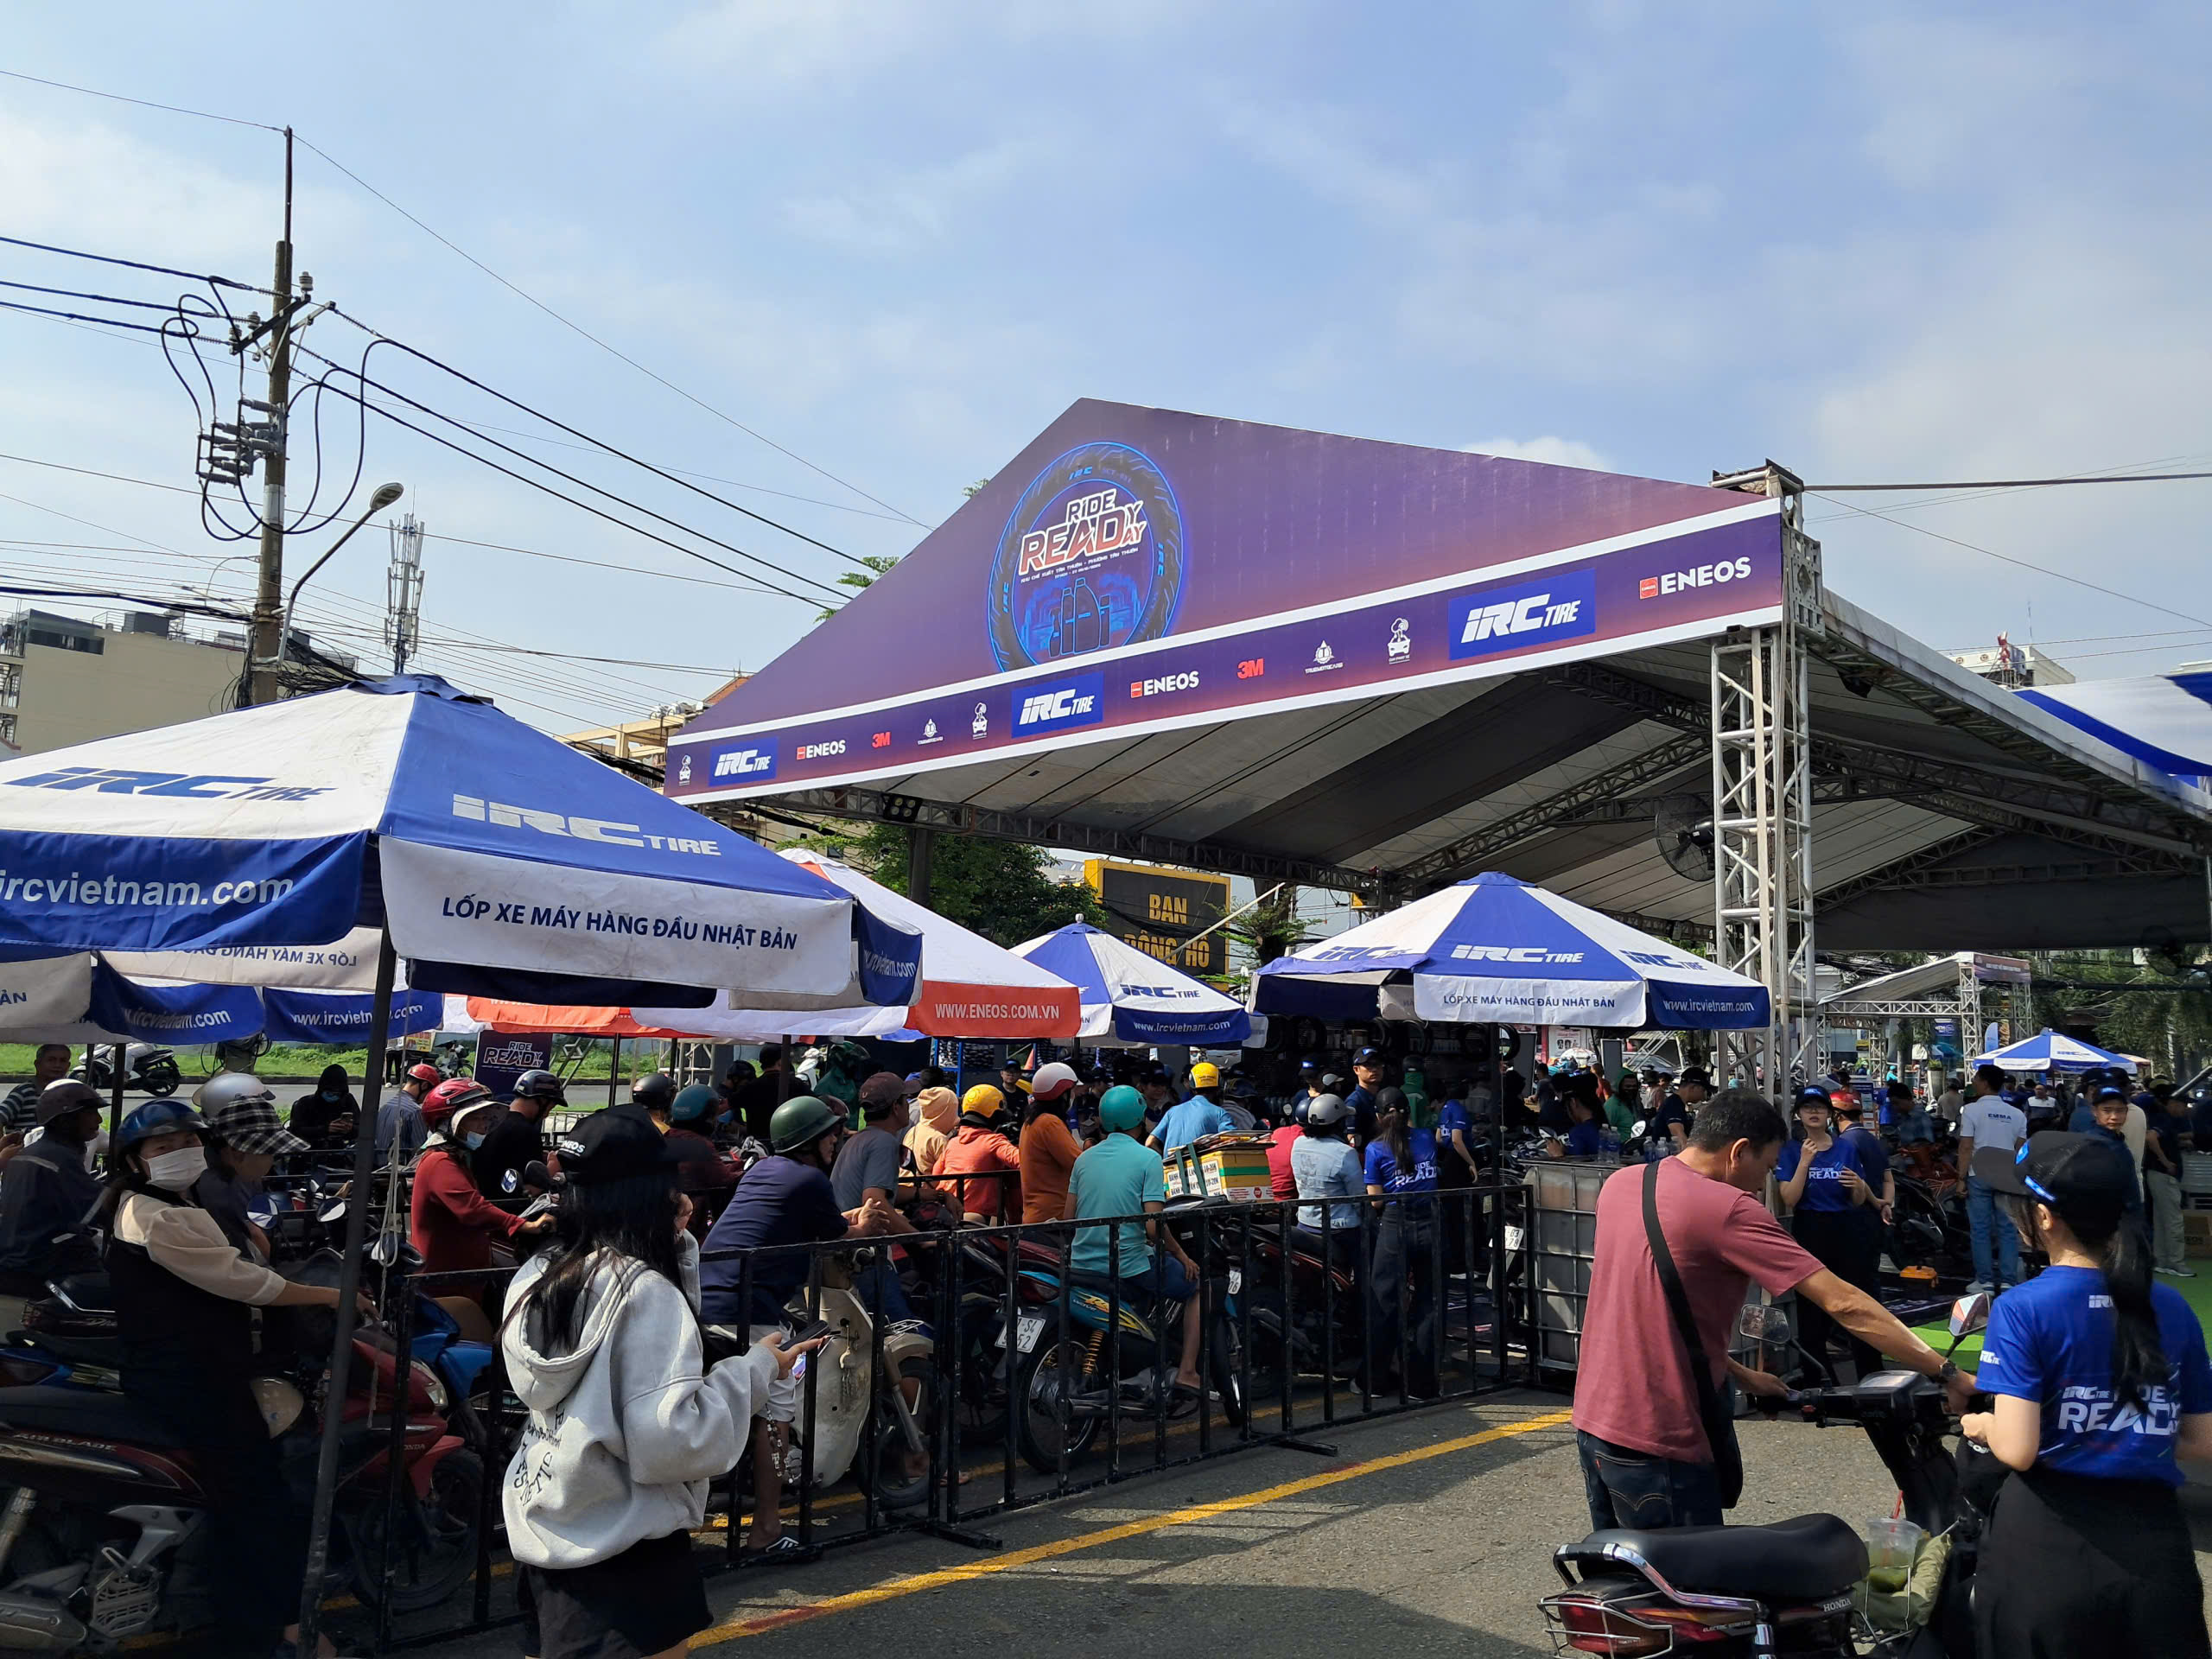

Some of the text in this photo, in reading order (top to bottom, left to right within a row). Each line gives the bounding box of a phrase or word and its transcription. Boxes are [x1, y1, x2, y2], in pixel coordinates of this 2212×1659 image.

[1066, 488, 1116, 523] RIDE
[805, 740, 847, 760] ENEOS
[872, 732, 892, 748] 3M
[1071, 696, 1095, 715] TIRE
[1143, 671, 1199, 696] ENEOS
[1237, 658, 1264, 678] 3M
[1543, 601, 1581, 626] TIRE
[1661, 556, 1751, 594] ENEOS
[225, 786, 338, 801] TIRE
[642, 835, 721, 855] TIRE
[1148, 893, 1188, 925] BAN
[442, 893, 798, 950] LỐP XE MÁY HÀNG ĐẦU NHẬT BẢN
[1544, 952, 1584, 963] TIRE
[1176, 990, 1201, 999] TIRE
[1465, 995, 1478, 1005] XE
[1480, 994, 1503, 1006] MÁY
[1505, 994, 1535, 1007] HÀNG
[1562, 997, 1592, 1009] NHẬT
[935, 1003, 1060, 1020] WWW.ENEOS.COM.VN
[1663, 998, 1755, 1013] www.ircvietnam.com
[509, 1041, 532, 1051] RIDE
[1822, 1598, 1852, 1612] HONDA
